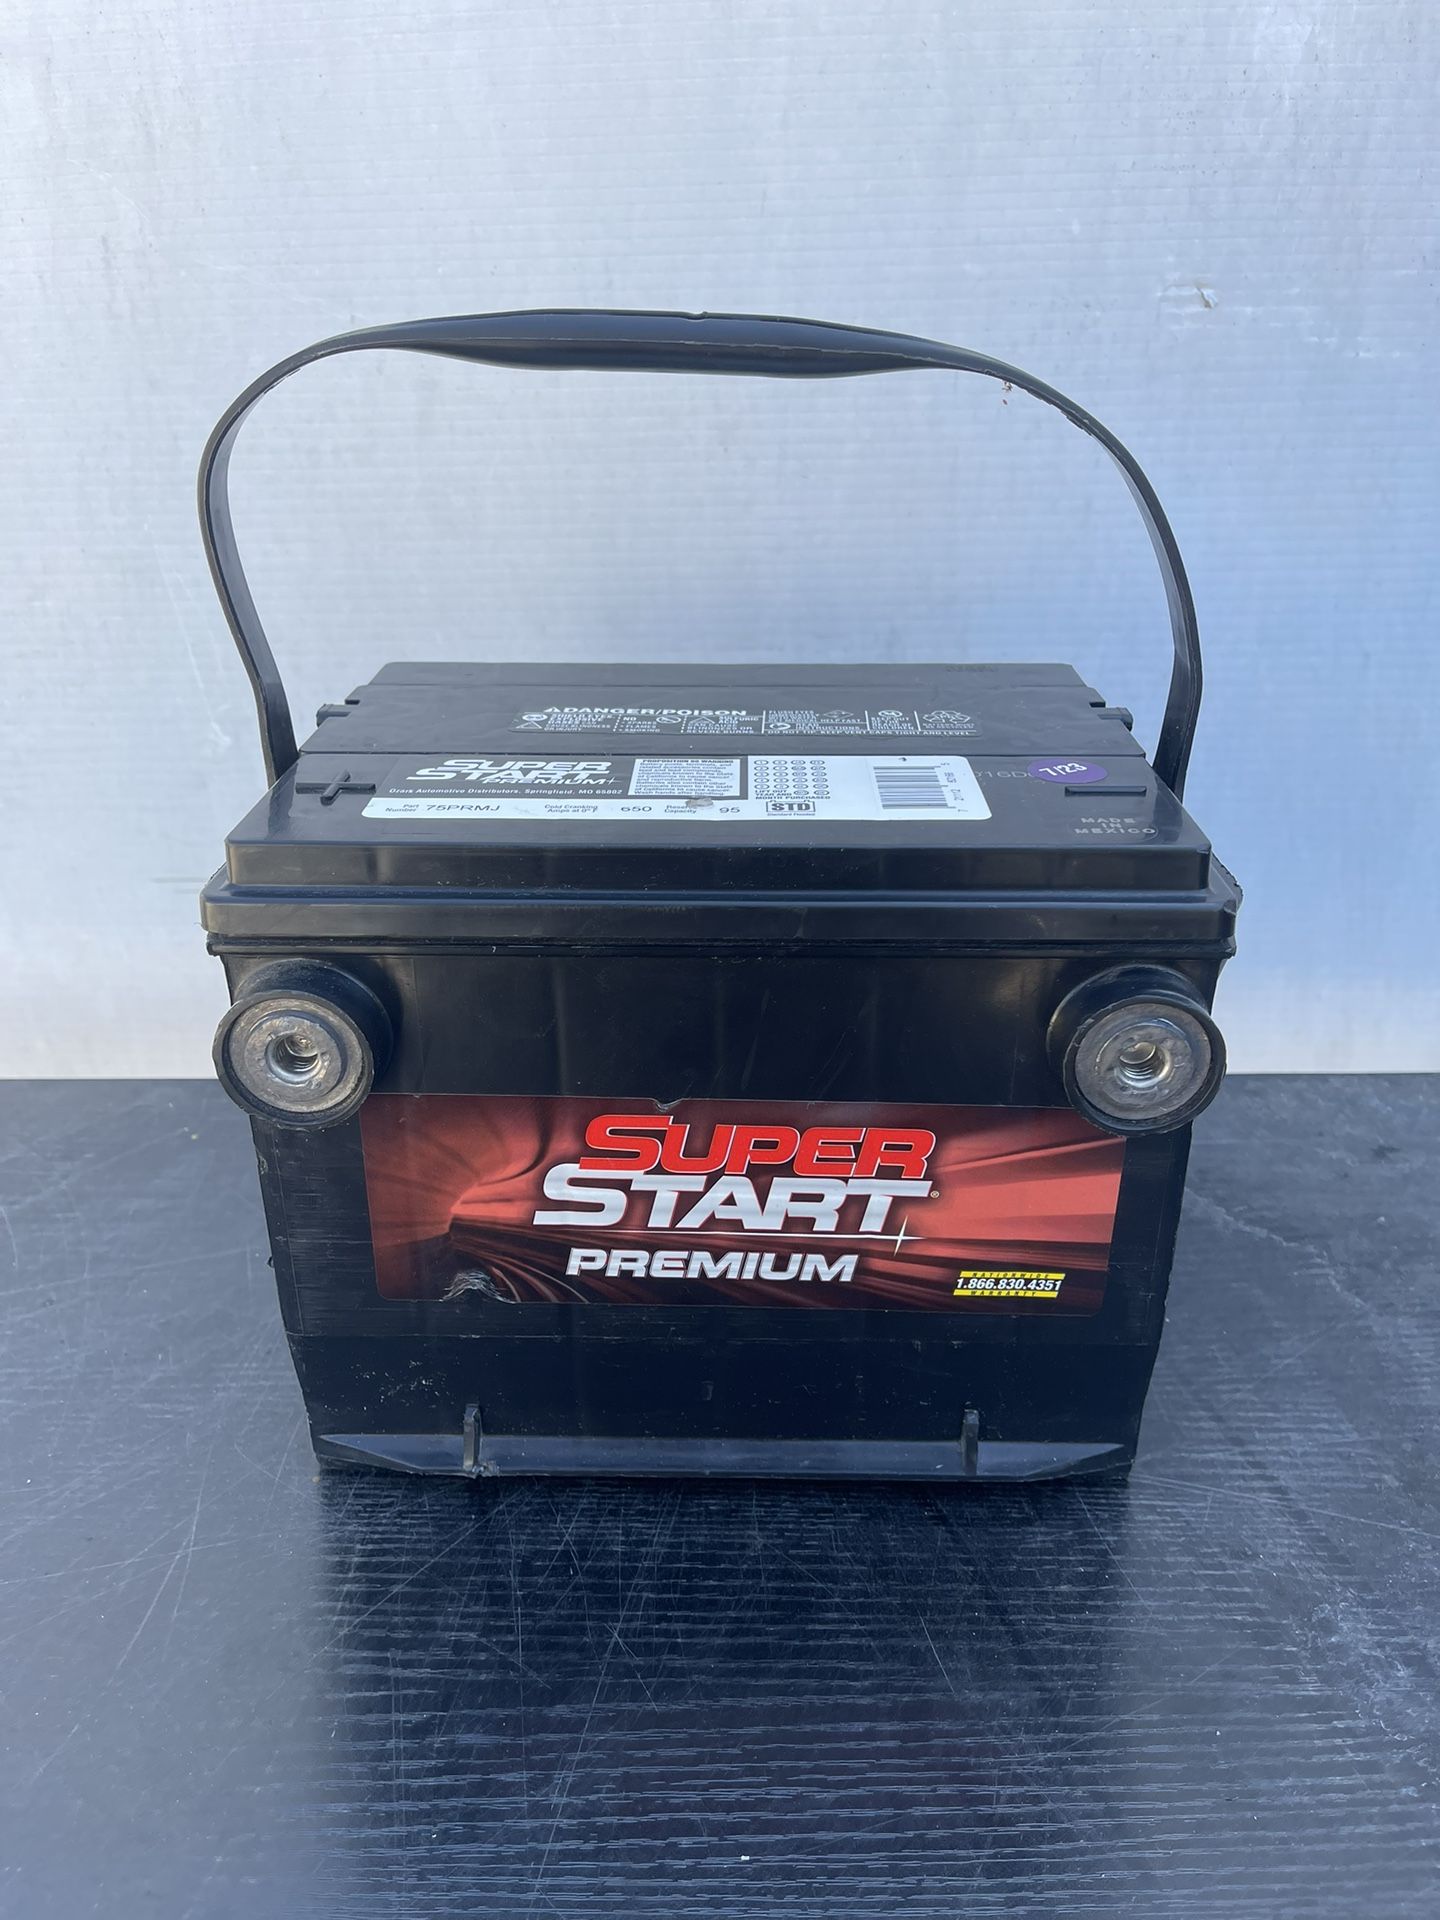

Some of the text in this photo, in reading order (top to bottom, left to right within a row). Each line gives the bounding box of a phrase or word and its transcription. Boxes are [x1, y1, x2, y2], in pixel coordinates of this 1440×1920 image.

[563, 707, 746, 716] DANGER/POISON
[439, 759, 612, 772] SUPER
[1038, 762, 1088, 776] 7/23
[406, 768, 611, 781] START
[771, 803, 811, 811] STD
[579, 1114, 937, 1179] SUPER
[533, 1163, 934, 1232] START
[565, 1247, 859, 1282] PREMIUM
[956, 1278, 1063, 1291] 1.866.830.4351
